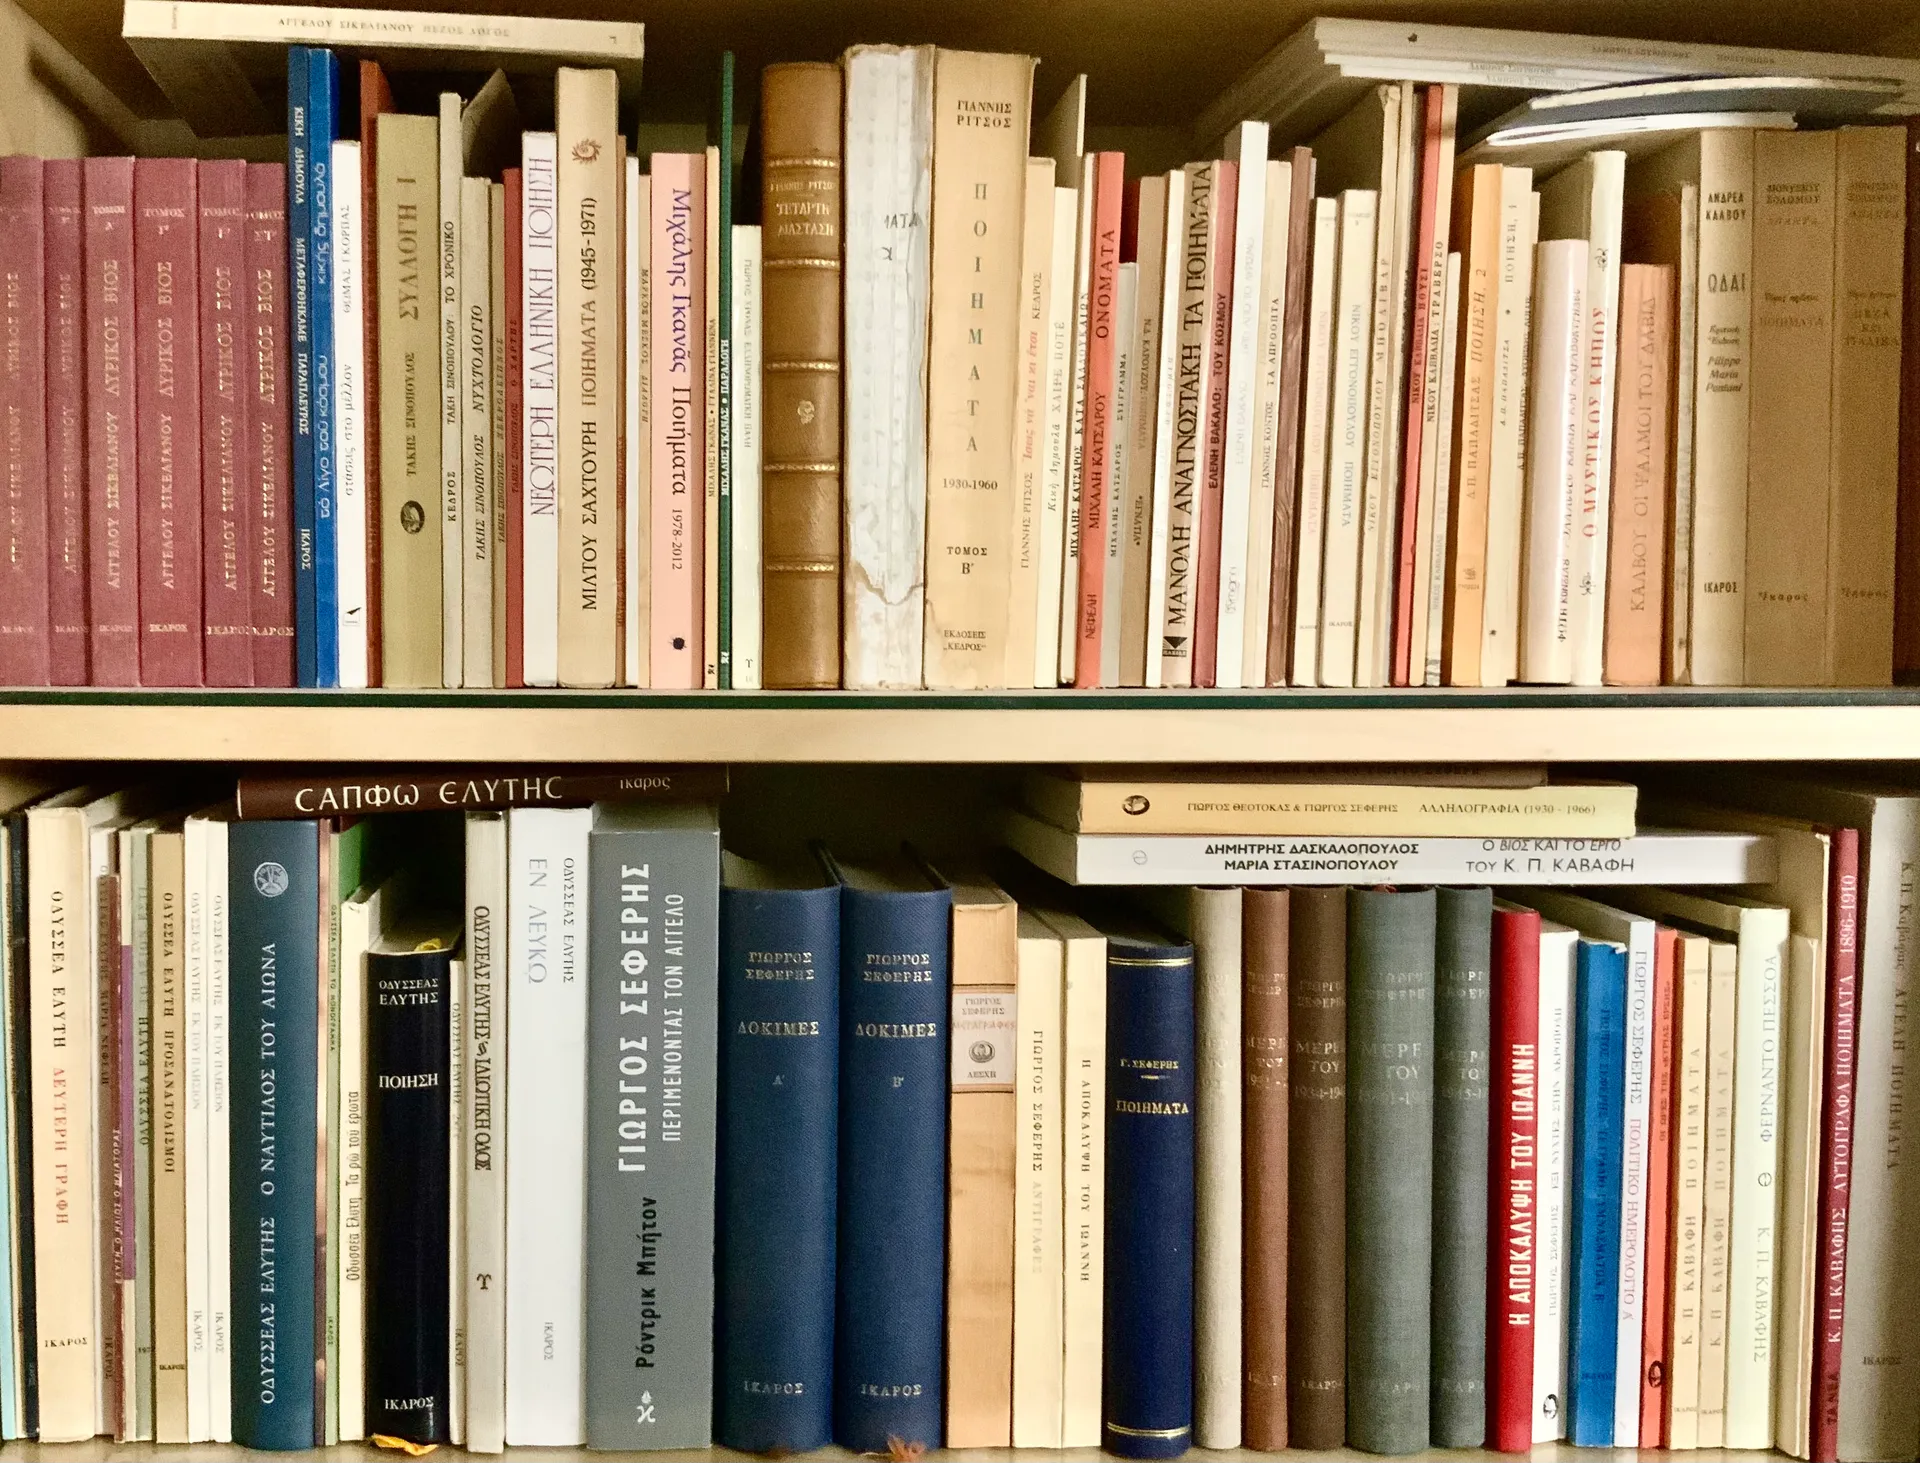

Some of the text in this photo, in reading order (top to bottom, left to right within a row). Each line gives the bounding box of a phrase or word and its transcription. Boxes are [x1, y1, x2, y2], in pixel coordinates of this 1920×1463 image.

[294, 107, 304, 136] ΚΙΚΗ
[956, 101, 1011, 113] ΓΙΑΝΝΗΣ
[956, 115, 1012, 127] ΡΙΤΣΟΣ
[295, 147, 305, 204] ΔΗΜΟΥΛΑ
[1708, 193, 1744, 204] ΑΝΔΡΕΑ
[666, 189, 694, 286] Μιχάλης
[1706, 209, 1747, 221] ΚΑΛΒΟΥ
[397, 204, 420, 320] ΣΥΛΛΟΓΗ
[444, 221, 454, 279] ΧΡΟΝΙΚΟ
[445, 287, 455, 303] ΤΟ
[1095, 229, 1115, 339] ΟΝΟΜΑΤΑ
[1707, 274, 1746, 293] ΩΔΑΙ
[527, 158, 556, 516] ΝΕΩΤΕΡΗ ΕΛΛΗΝΙΚΗ ΠΟΙΗΣΗ
[1214, 292, 1227, 346] ΚΟΣΜΟΥ
[405, 352, 415, 428] ΣΙΝΟΠΟΥΛΟΣ
[1214, 352, 1224, 376] ΤΟΥ
[158, 261, 173, 588] ΑΓΓΕΛΟΥ ΣΙΚΕΛΙΑΝΟΥ ΛΥΡΙΚΟΣ ΒΙΟΣ
[447, 396, 456, 424] ΤΑΚΗ
[579, 197, 598, 611] ΜΙΛΤΟΥ ΣΑΧΤΟΥΡΗ ΠΟΙΗΜΑΤΑ (1945-1971)
[1168, 168, 1211, 626] ΜΑΝΟΛΗ ΑΝΑΓΝΩΣΤΑΚΗ ΤΑ ΠΟΙΗΜΑΤΑ
[406, 435, 416, 476] ΤΑΚΗΣ
[471, 304, 485, 560] ΤΑΚΗΣ ΣΙΝΟΠΟΥΛΟΣ ΝΥΧΤΟΛΟΓΙΟ
[665, 386, 692, 495] Ποιήματα
[1090, 391, 1107, 467] ΚΑΤΣΑΡΟΥ
[447, 471, 456, 521] ΚΕΔΡΟΣ
[942, 478, 998, 492] 1930-1960
[1209, 448, 1220, 489] ΕΛΕΝΗ
[1631, 529, 1647, 612] ΚΑΛΒΟΥ
[1639, 359, 1654, 399] ΤΟΥ
[1088, 471, 1103, 529] ΜΙΧΑΛΗ
[300, 528, 312, 570] ΙΚΑΡΟΣ
[671, 507, 683, 570] 1978-2012
[946, 546, 988, 556] ΤΟΜΟΣ
[1582, 524, 1597, 537] Ο
[1704, 582, 1737, 593] ΙΚΑΡΟΣ
[1205, 842, 1419, 856] ΔΗΜΗΤΡΗΣ ΔΑΣΚΑΛΟΠΟΥΛΟΣ
[1224, 859, 1398, 872] ΜΑΡΙΑ ΣΤΑΣΙΝΟΠΟΥΛΟΥ
[1465, 857, 1634, 873] ΤΟΥ Κ. Π. ΚΑΒΑΦΗ
[1483, 839, 1621, 852] Ο ΒΙΟΣ ΚΑΙ ΤΟ ΕΡΓΟ
[527, 859, 548, 985] ΕΝ ΛΕΥΚΩ
[562, 857, 575, 983] ΟΔΥΣΣΕΑΣ ΕΛΥΤΗΣ
[1839, 875, 1856, 955] 1896-1910
[379, 980, 438, 989] ΟΔΥΣΣΕΑΣ
[745, 969, 814, 981] ΣΕΦΕΡΗΣ
[749, 952, 812, 965] ΓΙΩΡΓΟΣ
[864, 970, 932, 983] ΣΕΦΕΡΗΣ
[867, 954, 930, 966] ΓΙΩΡΓΟΣ
[1633, 950, 1648, 1022] ΓΙΩΡΓΟΣ
[379, 993, 438, 1004] ΕΛΥΤΗΣ
[618, 863, 650, 1172] ΓΙΩΡΓΟΣ ΣΕΦΕΡΗΣ
[662, 894, 683, 1141] ΠΕΡΙΜΕΝΟΝΤΑΣ ΤΟΝ ΑΓΓΕΛΟ
[1837, 974, 1854, 1075] ΠΟΙΗΜΑΤΑ
[163, 892, 175, 1173] ΟΔΥΣΣΕΑ ΕΛΥΤΗ ΠΡΟΣΑΝΑΤΟΛΙΣΜΟΙ
[473, 906, 491, 1170] ΟΔΥΣΣΕΑΣ ΕΛΥΤΗΣ ΙΔΙΩΤΙΚΗ ΟΔΟΣ
[738, 1021, 820, 1036] ΔΟΚΙΜΕΣ
[855, 1023, 936, 1038] ΔΟΚΙΜΕΣ
[1758, 954, 1778, 1142] ΦΕΡΝΑΝΤΟ ΠΕΣΣΟΑ
[51, 891, 71, 1225] ΟΔΥΣΣΕΑ ΕΛΥΤΗ ΔΕΥΤΕΡΗ ΓΡΑΦΗ
[378, 1073, 438, 1088] ΠΟΙΗΣΗ
[1033, 1030, 1043, 1095] ΓΙΩΡΓΟΣ
[1629, 1025, 1646, 1105] ΣΕΦΕΡΗΣ
[1117, 1101, 1189, 1115] ΠΟΙΗΜΑΤΑ
[1833, 1081, 1852, 1192] ΑΥΤΟΓΡΑΦΑ
[1033, 1103, 1043, 1172] ΣΕΦΕΡΗΣ
[1627, 1118, 1642, 1196] ΠΟΛΙΤΙΚΟ
[260, 942, 276, 1403] ΟΔΥΣΣΕΑΣ ΕΛΥΤΗΣ Ο ΝΑΥΤΙΛΟΣ ΤΟΥ ΑΙΩΝΑ
[1081, 1059, 1091, 1281] Η ΑΠΟΚΑΛΥΨΗ ΤΟΥ ΙΩΑΝΝΗ
[1509, 1044, 1535, 1325] Η ΑΠΟΚΑΛΥΨΗ ΤΟΥ ΙΩΑΝΝΗ
[1623, 1201, 1640, 1304] ΗΜΕΡΟΛΟΓΙΟ
[1830, 1207, 1846, 1296] ΚΑΒΑΦΗΣ
[636, 1196, 661, 1368] Ρόντρικ Μπήτον
[543, 1322, 554, 1360] ΙΚΑΡΟΣ
[1827, 1325, 1842, 1343] Κ.
[383, 1398, 435, 1411] ΙΚΑΡΟΣ
[744, 1382, 804, 1394] ΙΚΑΡΟΣ
[861, 1384, 921, 1396] ΙΚΑΡΟΣ
